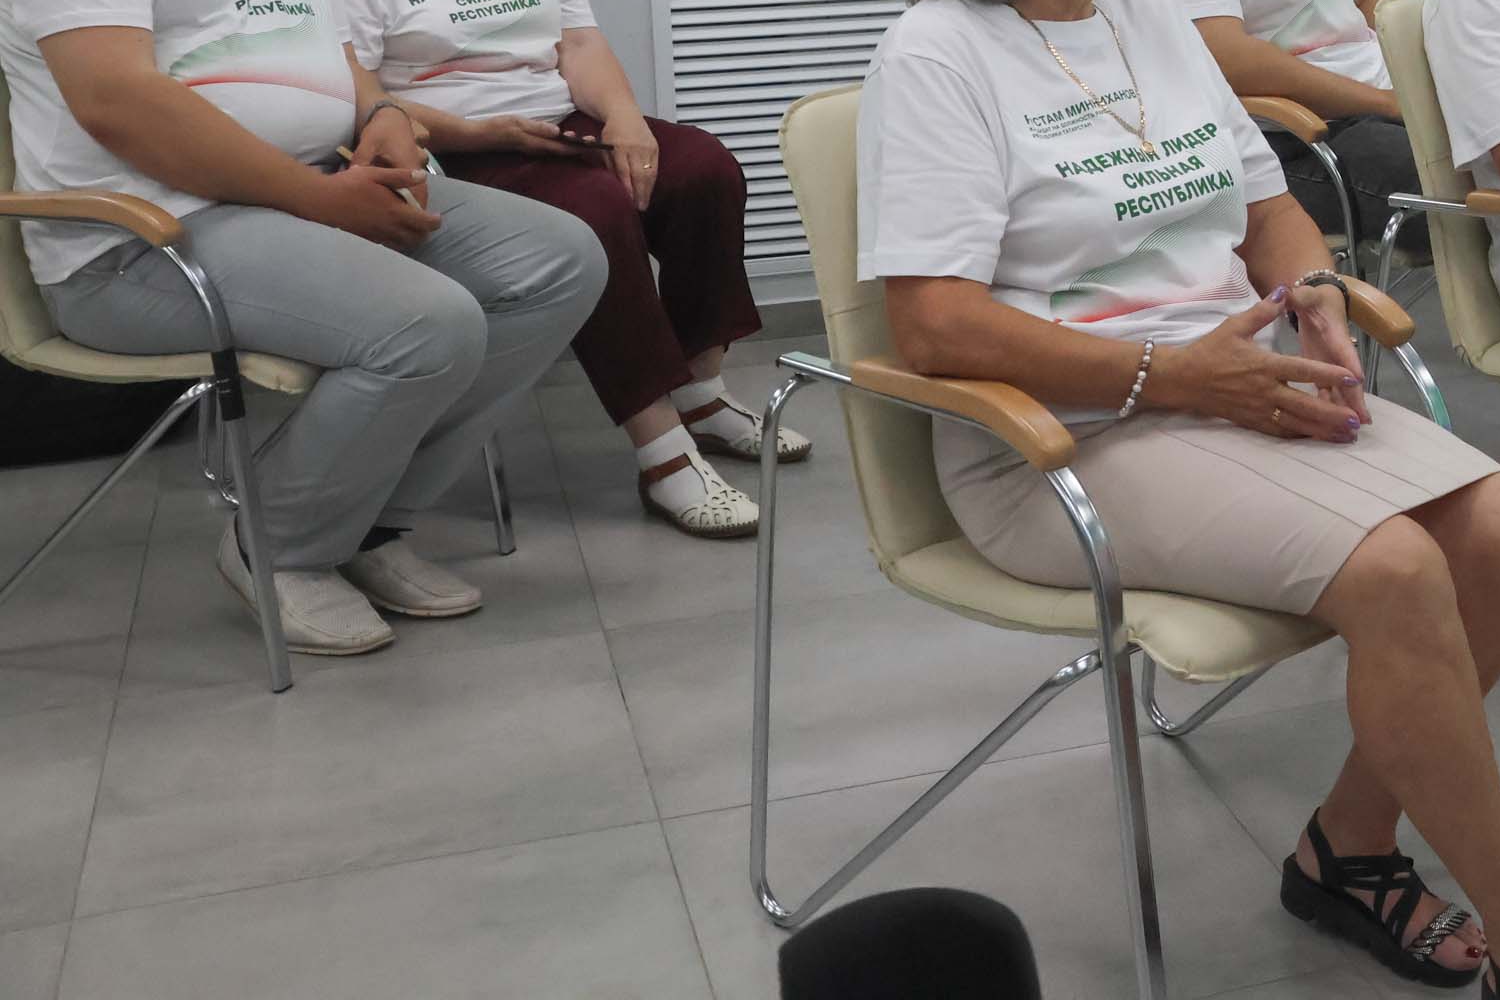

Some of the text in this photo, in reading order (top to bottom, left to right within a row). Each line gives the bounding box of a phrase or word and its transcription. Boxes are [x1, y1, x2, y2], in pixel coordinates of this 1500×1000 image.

[1161, 122, 1218, 156] ЛИДЕР
[1122, 155, 1205, 189] СИЛЬНАЯ
[1114, 169, 1234, 221] РЕСПУБЛИКА!
